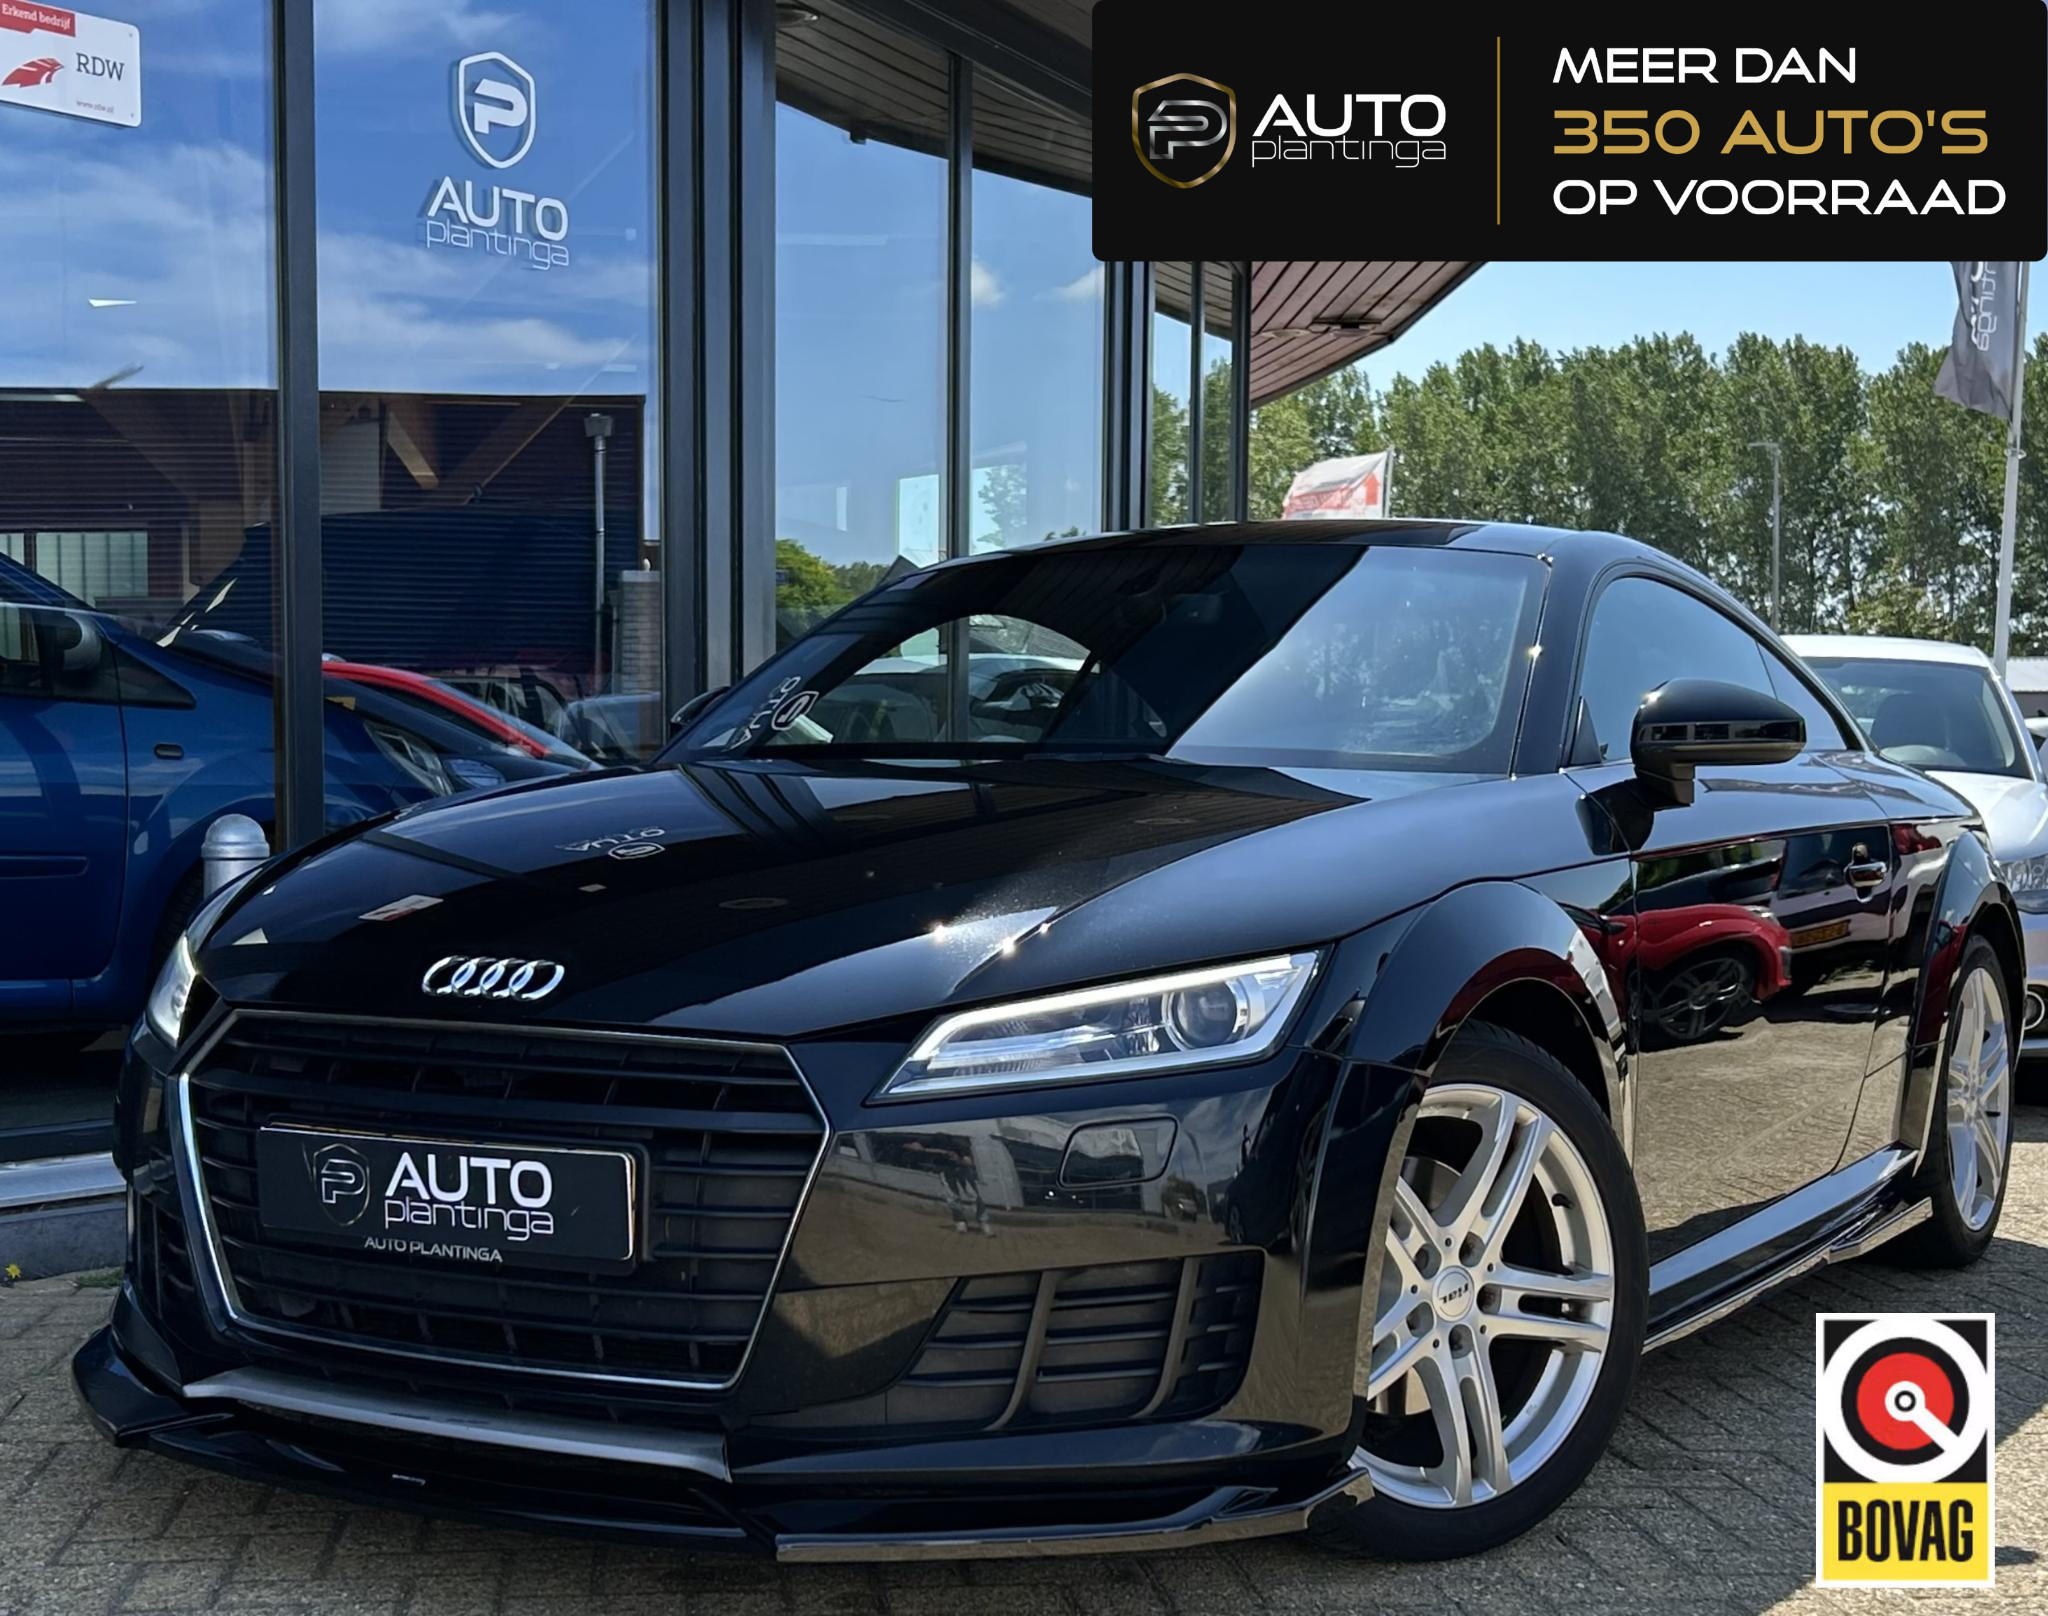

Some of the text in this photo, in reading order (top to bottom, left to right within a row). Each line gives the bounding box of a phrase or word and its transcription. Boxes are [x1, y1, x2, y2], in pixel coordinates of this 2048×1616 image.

[2, 3, 72, 30] Erkend bedrijf
[76, 52, 125, 81] RDW
[427, 176, 569, 241] AUTO
[426, 218, 570, 271] plantinga
[384, 1152, 553, 1208] AUTO
[384, 1197, 554, 1241] plantinga
[364, 1236, 503, 1263] AUTO PLANTINGA
